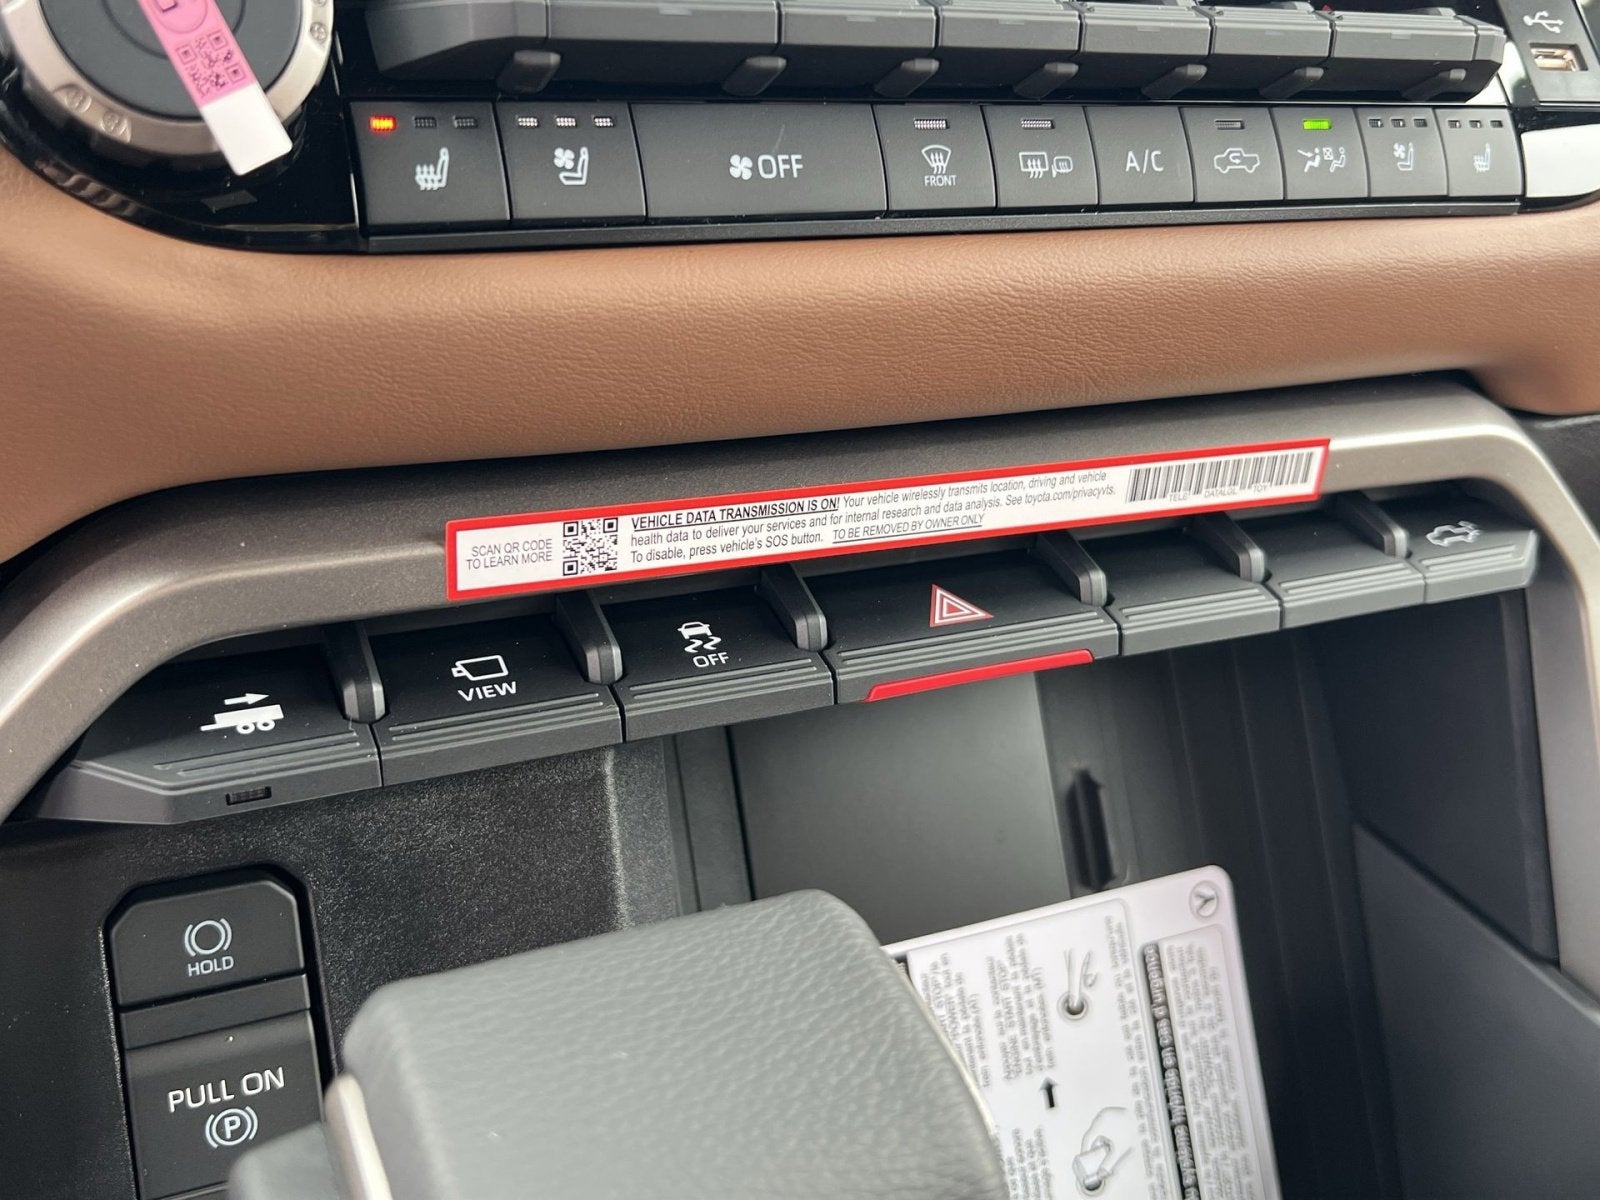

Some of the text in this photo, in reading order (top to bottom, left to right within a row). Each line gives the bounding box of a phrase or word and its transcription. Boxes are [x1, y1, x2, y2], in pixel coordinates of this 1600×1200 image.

[757, 153, 804, 179] OFF
[1124, 149, 1165, 174] A/C
[924, 175, 957, 187] FRONT
[630, 470, 1107, 529] VEHICLE DATA TRANSMISSION IS ON! Your vehicle wirelessly transmits location, driving and vehicle
[630, 531, 663, 547] health
[665, 528, 689, 543] data
[691, 527, 702, 540] to
[705, 523, 739, 539] deliver
[741, 522, 764, 537] your
[765, 517, 807, 532] services
[808, 514, 827, 528] and
[829, 512, 843, 526] for
[844, 508, 880, 524] internal
[881, 504, 920, 520] research
[923, 502, 941, 515] and
[942, 500, 963, 513] data
[964, 495, 1003, 513] analysis.
[1004, 493, 1023, 506] See
[471, 537, 553, 558] SCAN QR CODE
[631, 512, 985, 563] To disable, press vehicle's SOS button. TO BE REMOVED BY OWNER ONLY
[466, 549, 553, 571] TO LEARN MORE
[692, 652, 729, 668] OFF
[458, 681, 518, 702] VIEW
[188, 955, 235, 977] HOLD
[168, 1066, 286, 1113] PULL ON
[223, 1115, 242, 1139] P
